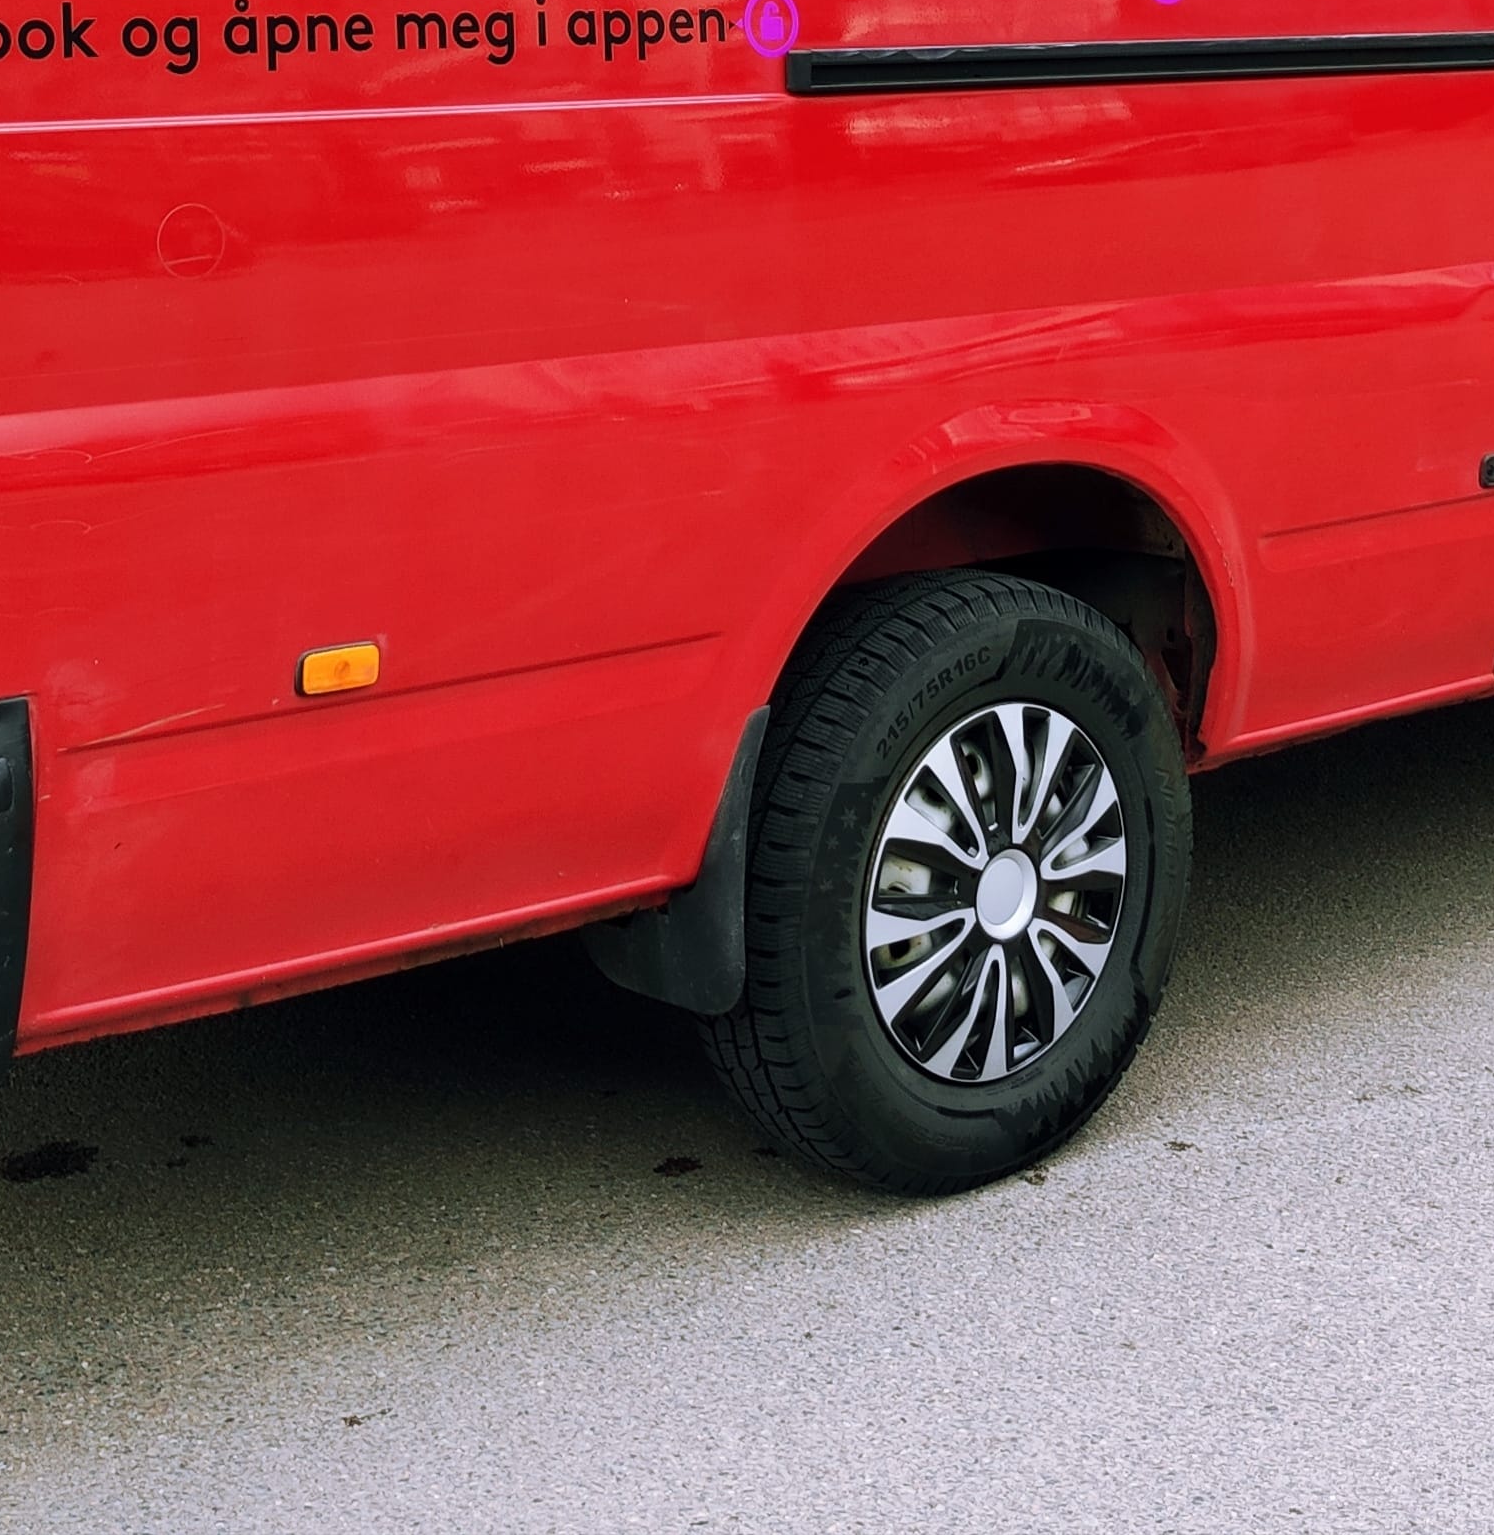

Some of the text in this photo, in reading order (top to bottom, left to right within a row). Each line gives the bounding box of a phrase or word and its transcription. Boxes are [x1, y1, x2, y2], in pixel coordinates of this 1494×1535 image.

[122, 17, 199, 75] og
[396, 12, 515, 65] meg
[567, 8, 725, 61] appen
